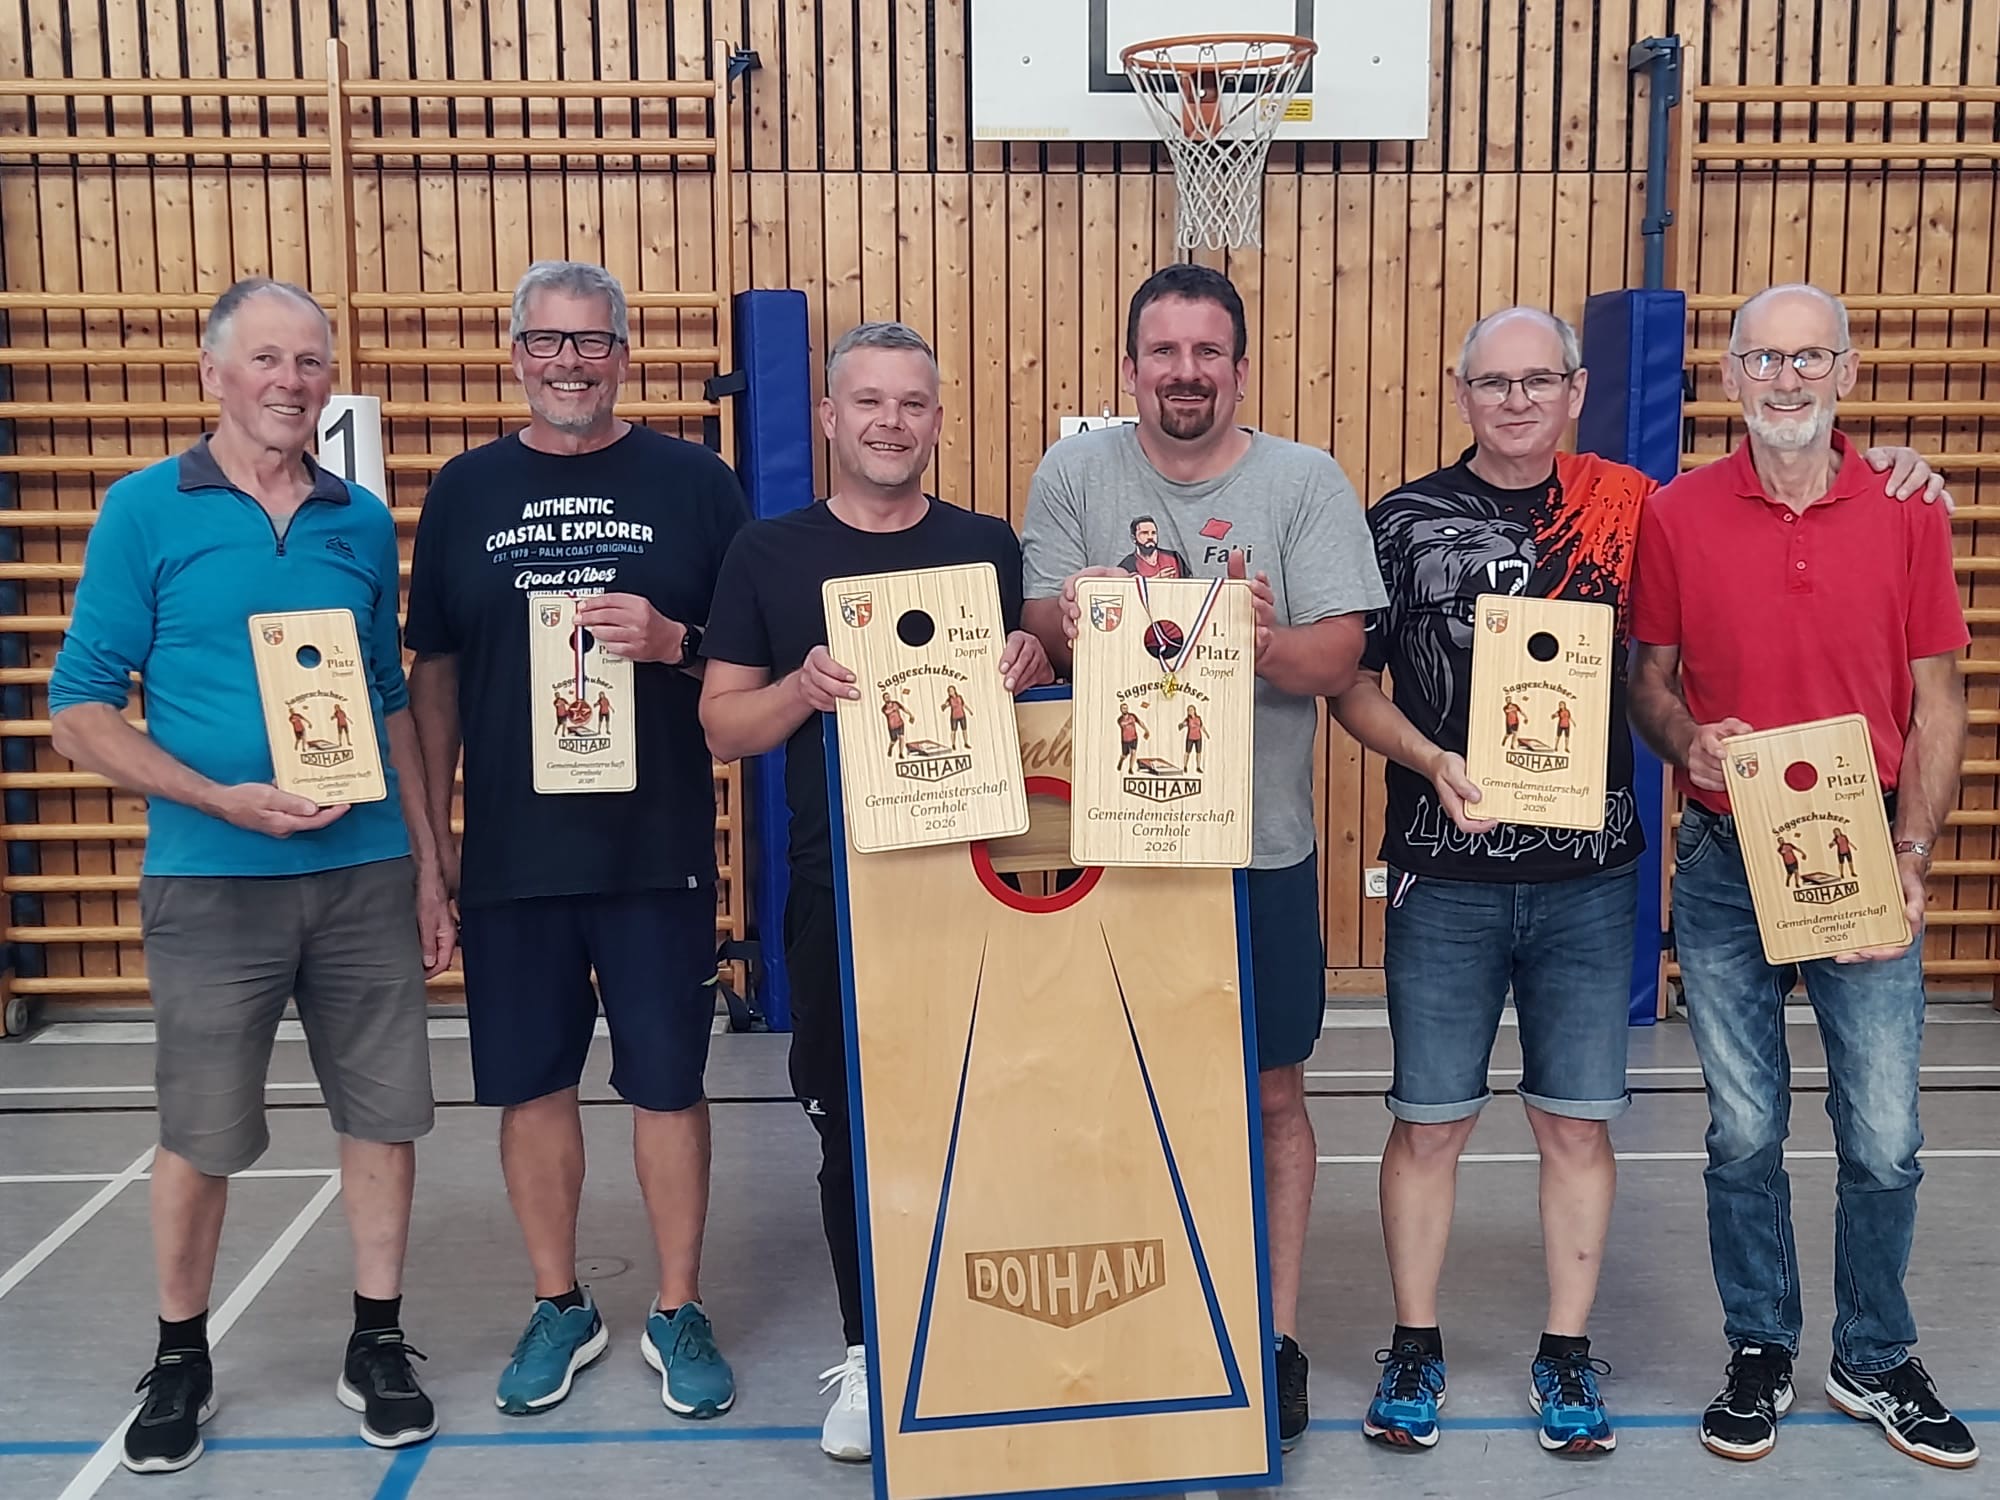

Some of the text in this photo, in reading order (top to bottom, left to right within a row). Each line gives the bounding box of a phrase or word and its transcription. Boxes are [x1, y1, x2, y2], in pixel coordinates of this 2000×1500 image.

[325, 409, 357, 484] 1
[522, 497, 615, 520] AUTHENTIC
[486, 520, 653, 552] COASTAL EXPLORER
[538, 547, 564, 558] PALM
[565, 545, 594, 557] COAST
[595, 543, 645, 554] ORIGINALS
[1203, 545, 1252, 564] Fai
[514, 566, 617, 590] Good Vibes
[960, 605, 974, 619] 1.
[947, 626, 991, 643] Platz
[1211, 622, 1225, 637] 1.
[1578, 634, 1590, 646] 2.
[954, 646, 988, 658] Doppel
[1195, 644, 1240, 661] Platz
[1565, 651, 1602, 666] Platz
[327, 659, 354, 669] Platz
[877, 664, 968, 692] Saggeschubser
[1200, 667, 1234, 680] Doppel
[900, 757, 969, 778] DOIHAM
[1509, 754, 1566, 769] DOIHAM
[1835, 755, 1850, 768] 2.
[1827, 773, 1867, 788] Platz
[865, 779, 1008, 807] Gemeindemeisterschaft
[1127, 780, 1197, 798] DOIHAM
[1514, 790, 1557, 803] Cornhole
[910, 800, 967, 818] Cornhole
[1522, 804, 1546, 813] 2026
[925, 817, 956, 831] 2026
[1087, 807, 1235, 826] Gemeindemeisterschaft
[1132, 823, 1191, 837] Cornhole
[1144, 840, 1177, 852] 2026
[1798, 883, 1856, 901] DOIHAM
[1776, 904, 1887, 930] Gemeindemeisterschaft
[1811, 921, 1856, 935] Cornhole
[1824, 933, 1848, 944] 2026
[974, 1246, 1156, 1315] DOIHAM
